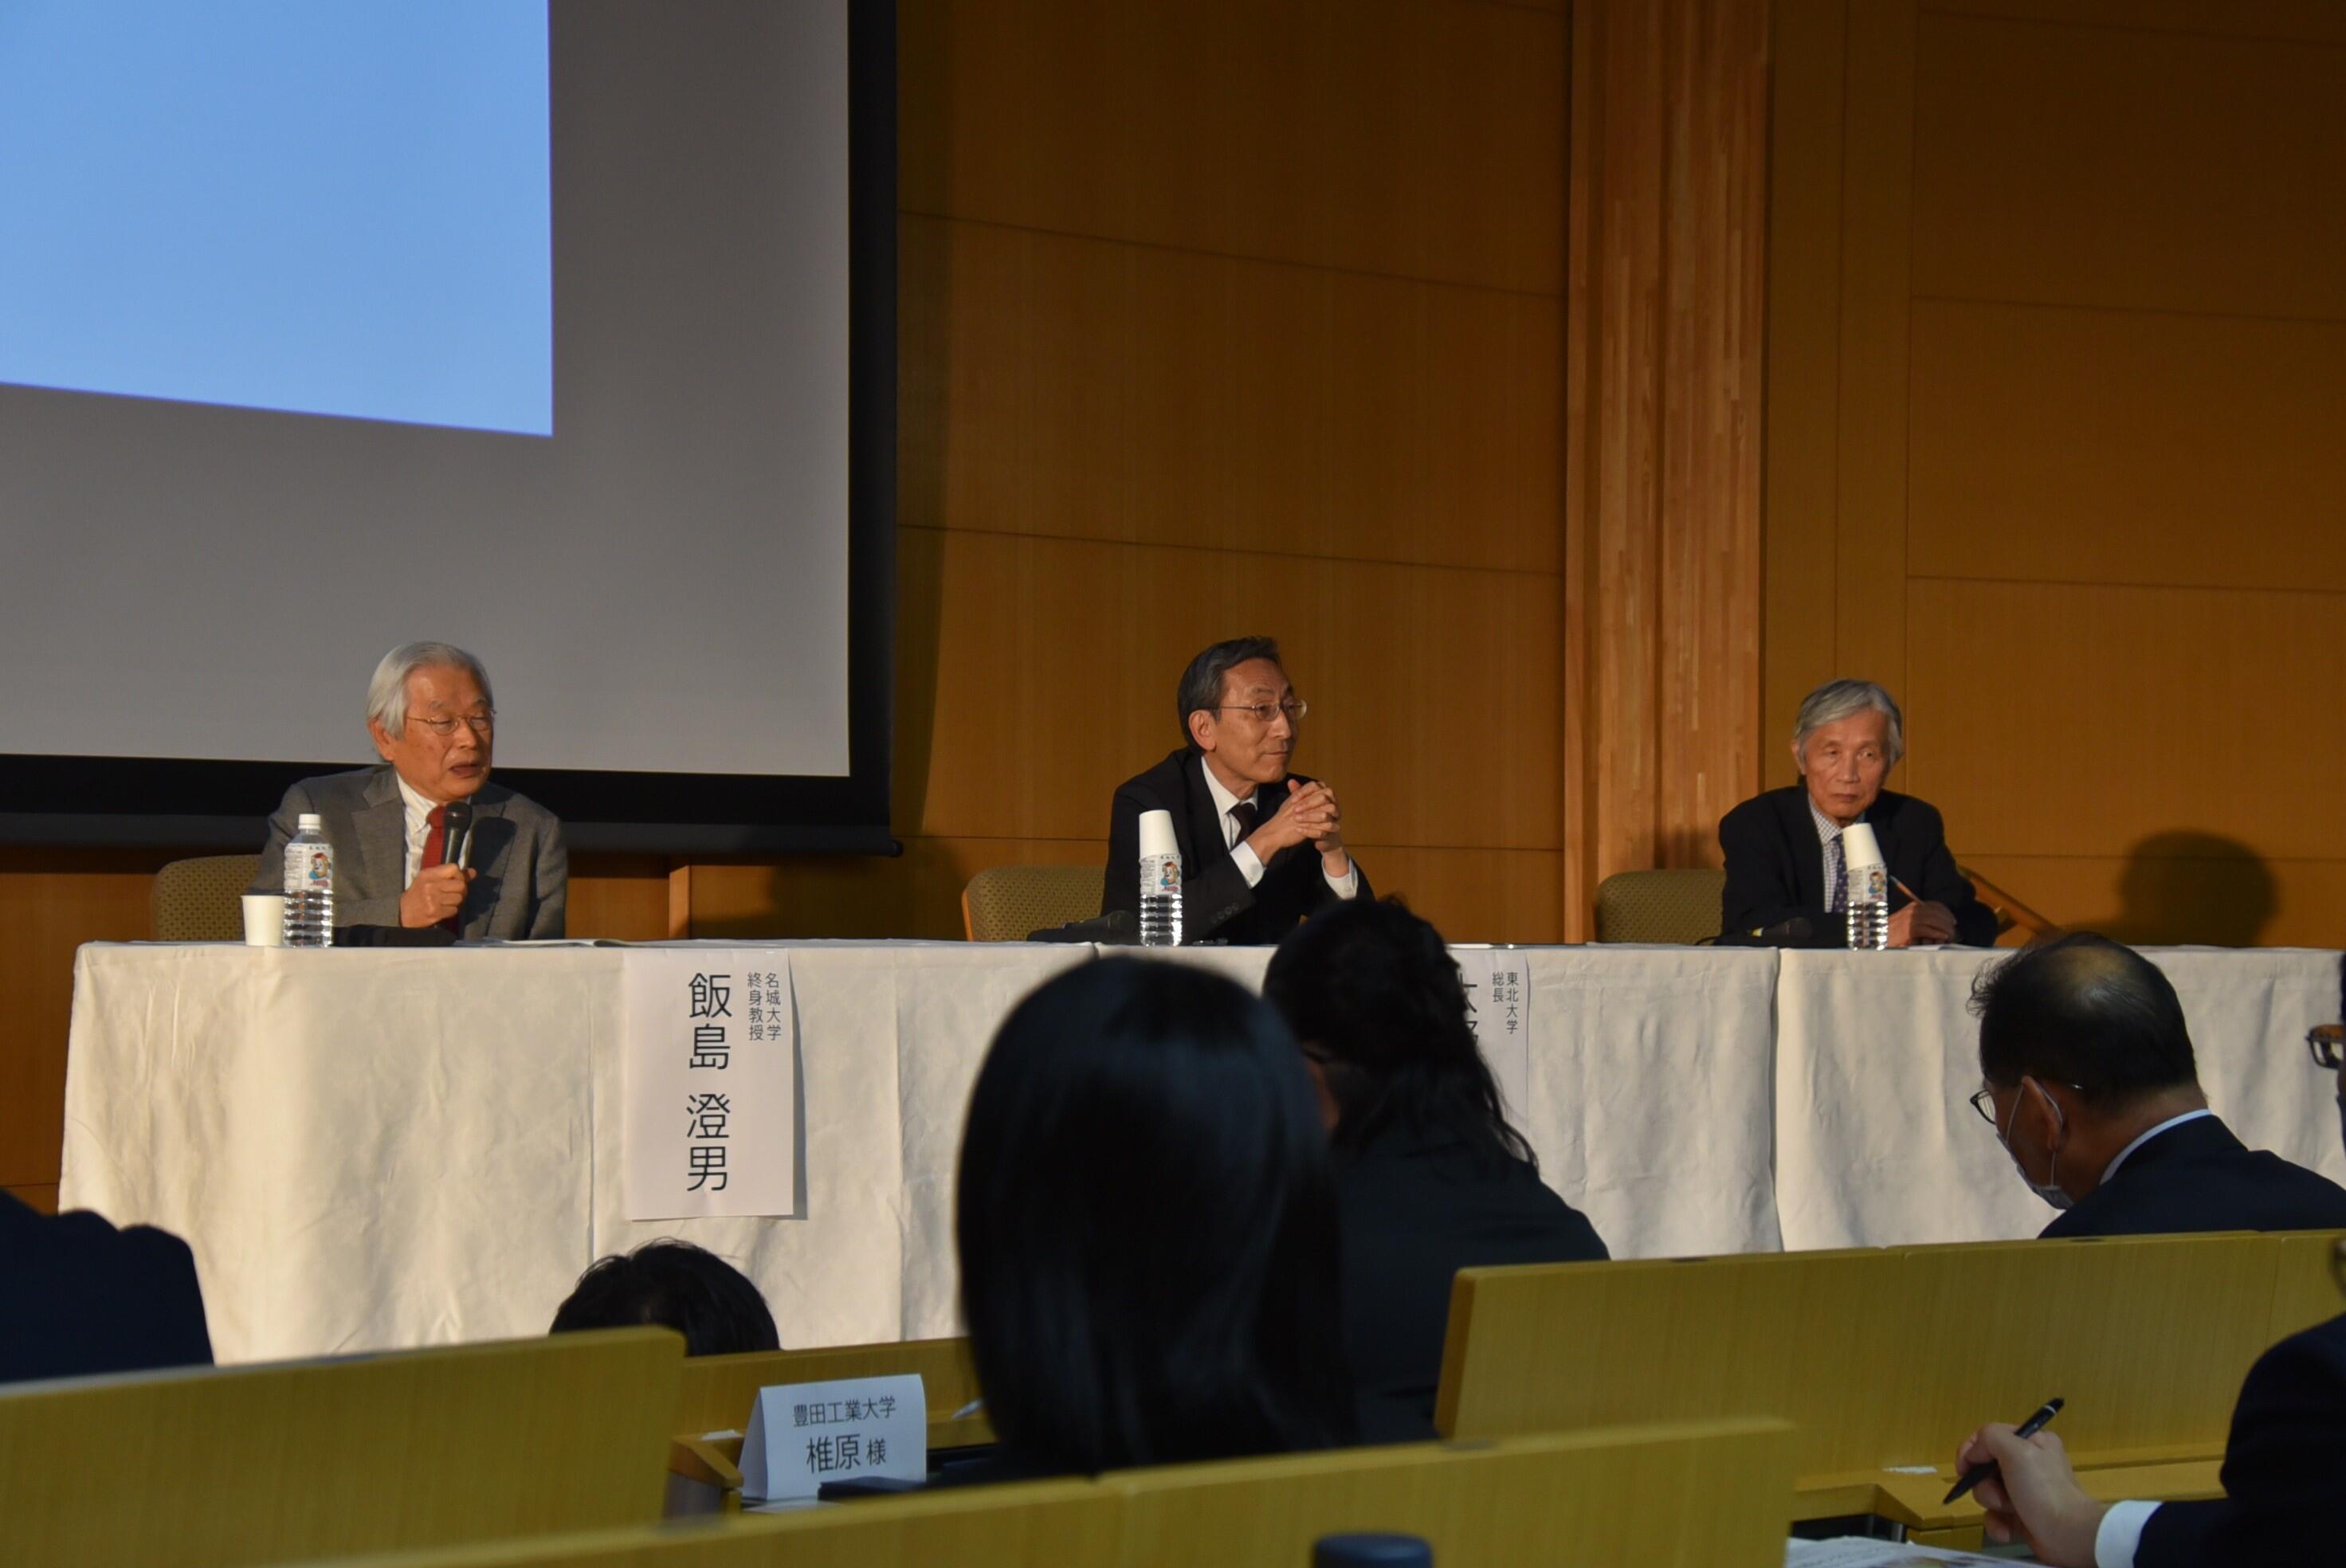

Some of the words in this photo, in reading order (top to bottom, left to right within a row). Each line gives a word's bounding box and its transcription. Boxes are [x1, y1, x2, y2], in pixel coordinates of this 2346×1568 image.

[747, 971, 764, 1041] 終身教授
[765, 971, 782, 1041] 名城大学
[1492, 971, 1504, 1002] 総長
[1506, 971, 1520, 1034] 東北大学
[688, 972, 732, 1069] 飯島
[686, 1093, 731, 1191] 澄男
[794, 1395, 896, 1427] 豊田工業大学
[806, 1433, 861, 1473] 椎原
[866, 1438, 886, 1466] 様
